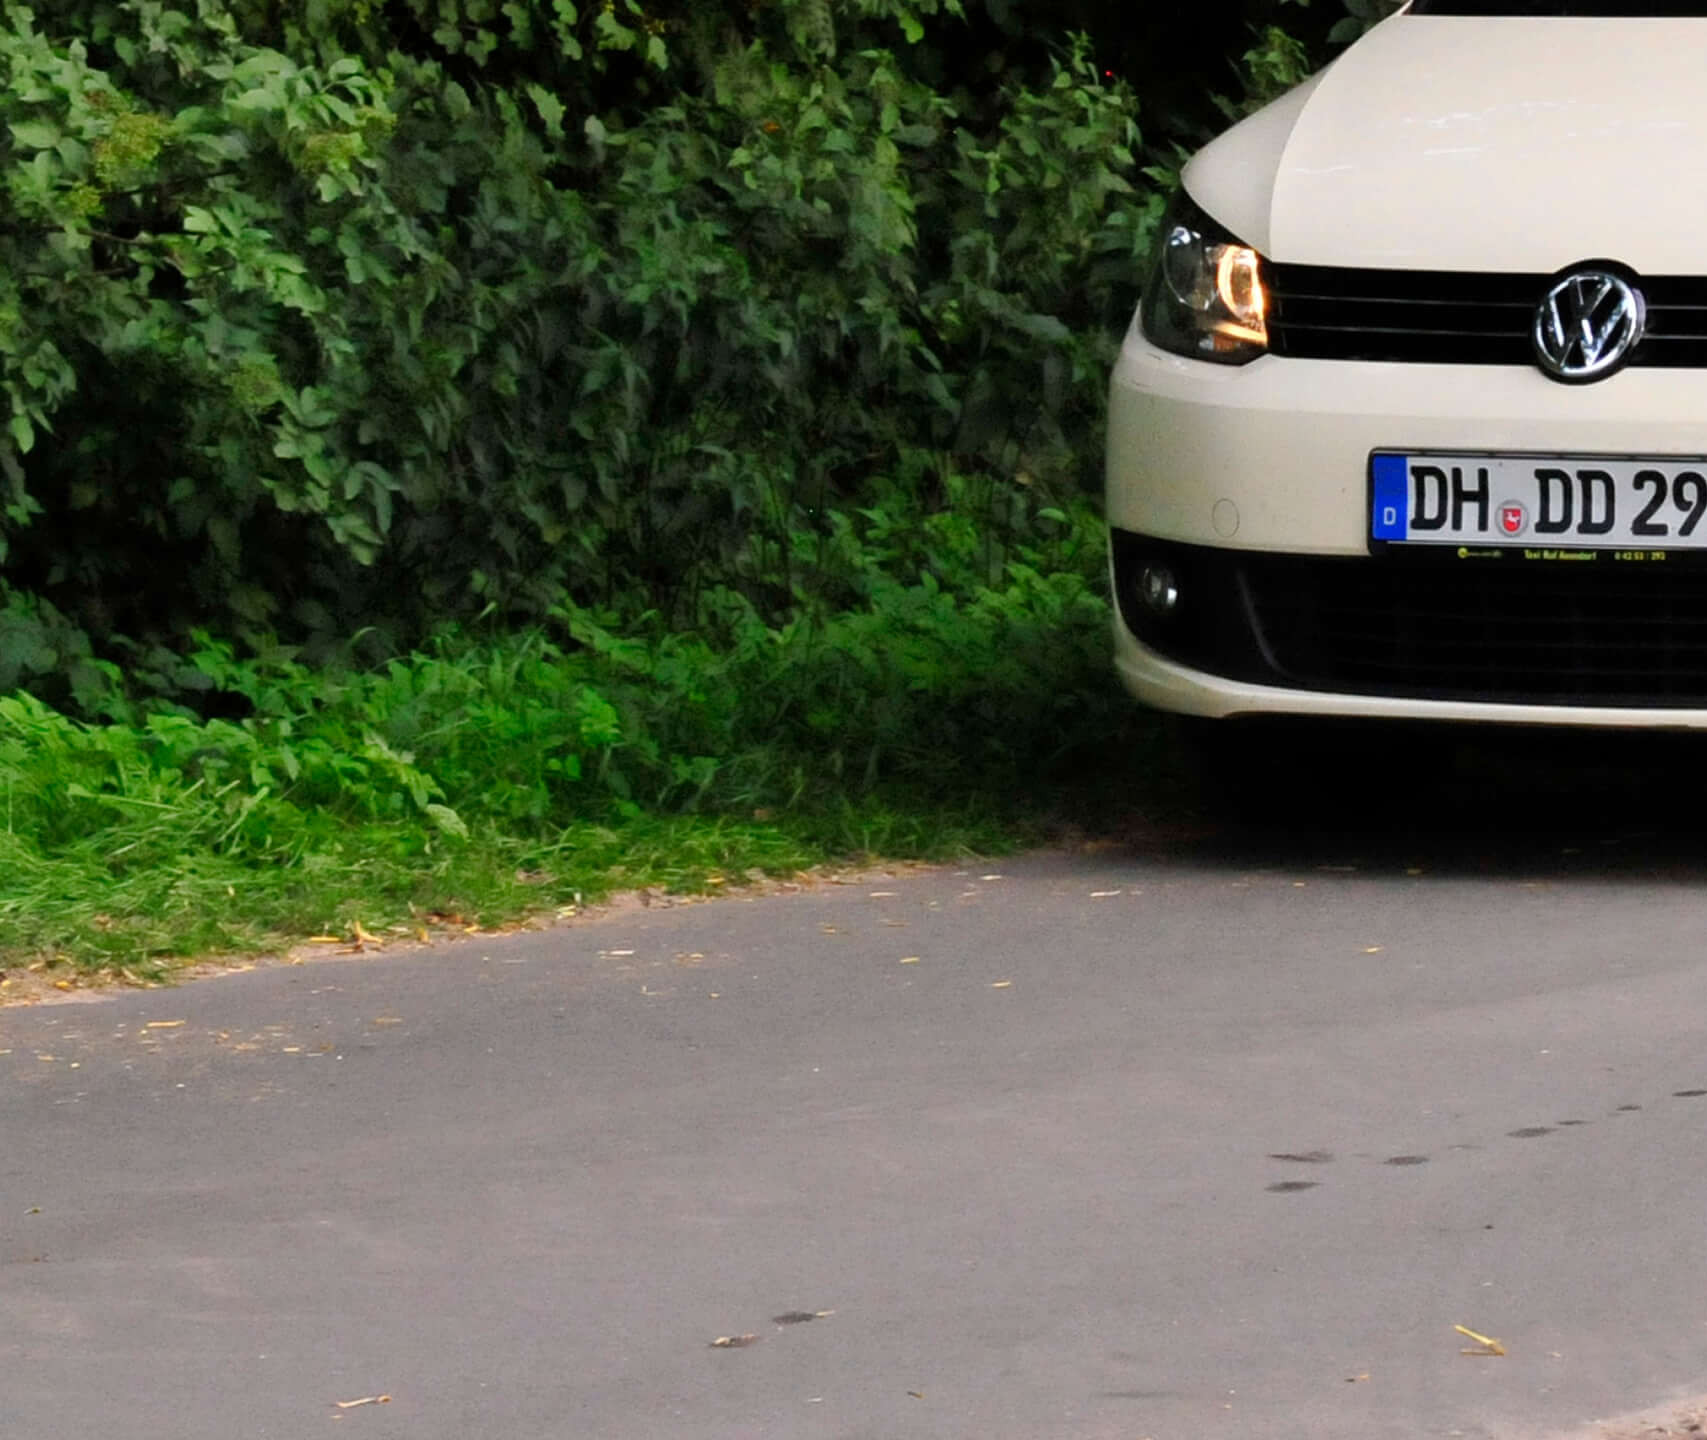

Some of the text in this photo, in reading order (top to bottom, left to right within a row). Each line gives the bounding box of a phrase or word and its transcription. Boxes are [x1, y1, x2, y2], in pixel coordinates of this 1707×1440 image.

[1383, 508, 1396, 525] D
[1410, 465, 1489, 531] DH
[1534, 468, 1616, 534] DD
